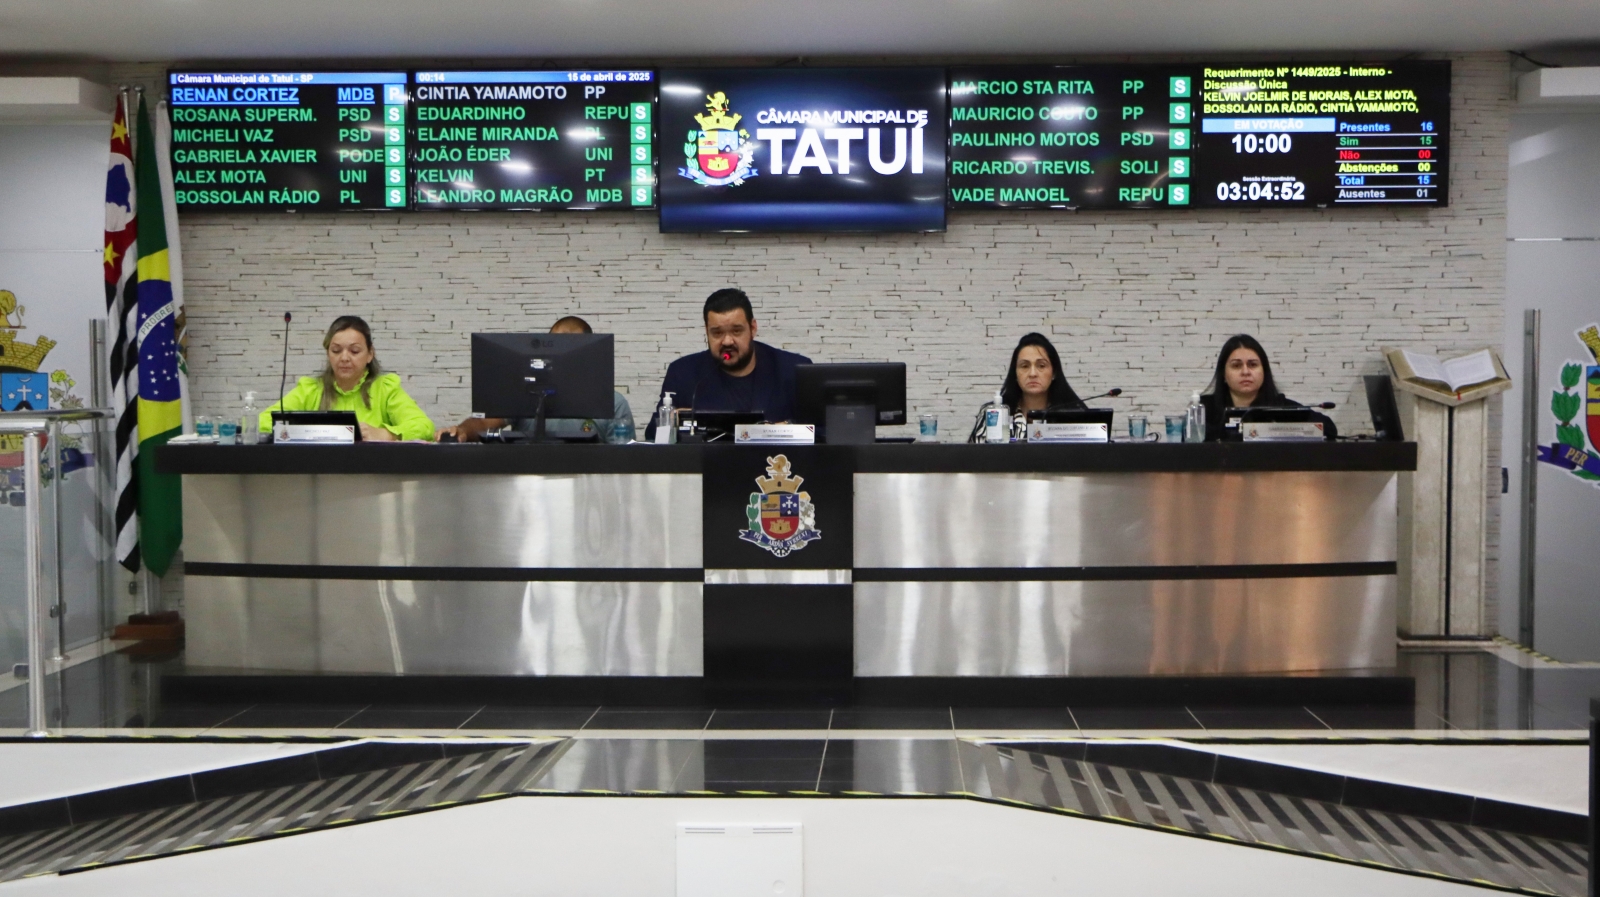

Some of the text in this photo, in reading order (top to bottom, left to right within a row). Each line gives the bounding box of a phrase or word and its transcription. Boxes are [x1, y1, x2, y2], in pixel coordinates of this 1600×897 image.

[178, 74, 211, 83] Câmara
[213, 74, 257, 84] Municipal
[258, 74, 269, 83] de
[300, 75, 313, 83] SP
[419, 73, 445, 82] 00:14
[568, 73, 650, 81] 15 de abril de 2025
[1204, 68, 1274, 80] Requerimento
[1291, 68, 1341, 77] 1449/2025
[1350, 68, 1385, 77] Interno
[952, 80, 1094, 94] MARCIO STA RITA
[1123, 80, 1144, 94] PP
[1174, 79, 1186, 94] S
[1204, 77, 1287, 90] Discussão Única
[172, 87, 299, 101] RENAN CORTEZ
[338, 87, 374, 101] MDB
[389, 87, 400, 100] P
[417, 86, 567, 100] CINTIA YAMAMOTO
[585, 86, 605, 99] PP
[1204, 90, 1417, 102] KELVIN JOELMIR DE MORAIS, ALEX MOTA,
[418, 107, 526, 120] EDUARDINHO
[585, 106, 629, 120] REPU
[634, 105, 646, 120] S
[952, 107, 1098, 120] MAURICIO COUTO
[1122, 106, 1144, 120] PP
[1174, 106, 1185, 120] S
[1204, 101, 1419, 114] BOSSOLAN DA RÁDIO, CINTIA YAMAMOTO,
[173, 108, 317, 122] ROSANA SUPERM.
[339, 108, 371, 122] PSD
[389, 108, 400, 122] S
[757, 108, 928, 124] CÂMARA MUNICIPAL DE
[1234, 119, 1304, 131] EM VOTAÇÃO
[1340, 123, 1390, 132] Presentes
[1420, 122, 1433, 131] 16
[174, 129, 274, 142] MICHELI VAZ
[339, 129, 372, 142] PSD
[389, 128, 400, 142] S
[418, 127, 559, 141] ELAINE MIRANDA
[585, 127, 605, 140] PL
[634, 126, 646, 140] S
[952, 133, 1100, 146] PAULINHO MOTOS
[1121, 132, 1154, 146] PSD
[1174, 131, 1185, 146] S
[1232, 134, 1291, 154] 10:00
[1340, 137, 1358, 146] Sim
[1420, 136, 1432, 145] 15
[417, 145, 511, 162] JOÃO ÉDER
[585, 148, 612, 161] UNI
[635, 147, 646, 161] S
[756, 122, 928, 175] TATUÍ
[1340, 150, 1360, 160] Não
[1419, 150, 1431, 159] 00
[174, 150, 317, 163] GABRIELA XAVIER
[340, 150, 384, 163] PODE
[390, 149, 400, 163] S
[952, 161, 1094, 174] RICARDO TREVIS.
[1120, 160, 1158, 174] SOLI
[1174, 160, 1185, 174] S
[1339, 163, 1398, 174] Abstenções
[1418, 163, 1430, 172] 00
[175, 170, 266, 183] ALEX MOTA
[340, 170, 367, 183] UNI
[390, 170, 401, 184] S
[417, 169, 474, 182] KELVIN
[585, 168, 605, 182] PT
[635, 168, 646, 182] S
[1339, 176, 1364, 185] Total
[1418, 176, 1430, 185] 15
[176, 188, 320, 204] BOSSOLAN RÁDIO
[340, 190, 360, 204] PL
[390, 190, 401, 204] S
[417, 187, 573, 203] LEANDRO MAGRÃO
[587, 189, 623, 202] MDB
[636, 188, 647, 203] S
[952, 188, 1069, 202] VADE MANOEL
[1119, 188, 1163, 201] REPU
[1173, 187, 1184, 201] S
[1217, 182, 1305, 201] 03:04:52
[1339, 189, 1385, 198] Ausentes
[1416, 189, 1428, 198] 01
[1564, 446, 1588, 466] PER
